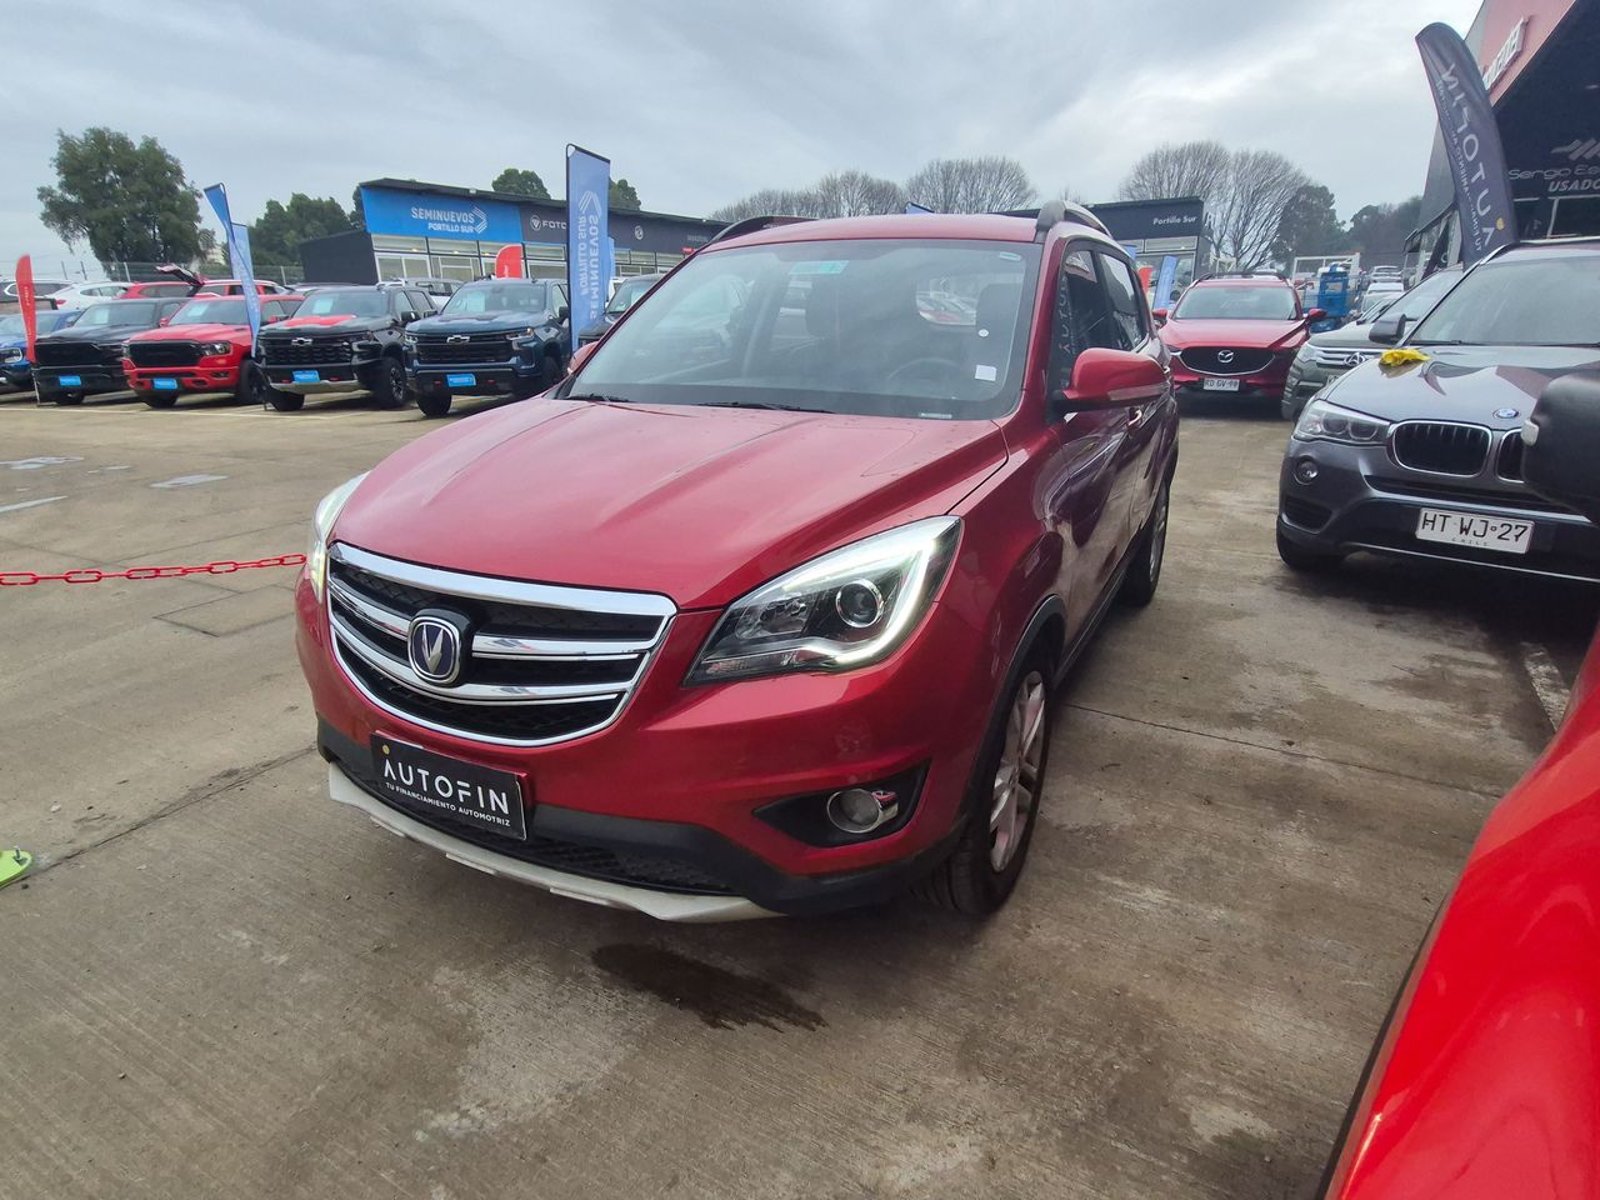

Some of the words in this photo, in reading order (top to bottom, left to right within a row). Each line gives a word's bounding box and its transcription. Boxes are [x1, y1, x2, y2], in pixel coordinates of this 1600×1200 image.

[411, 206, 475, 223] SEMINUEVOS
[1153, 216, 1181, 225] Portillo
[1182, 215, 1197, 223] Sur
[428, 222, 459, 232] PORTILLO
[460, 223, 475, 233] SUR
[1421, 512, 1451, 532] HT
[1459, 517, 1489, 538] WJ
[1497, 523, 1528, 542] 27
[384, 758, 509, 815] AUTOFIN
[386, 782, 395, 791] TU
[396, 785, 457, 811] FINANCIAMIENTO
[458, 806, 511, 827] AUTOMOTRIZ
